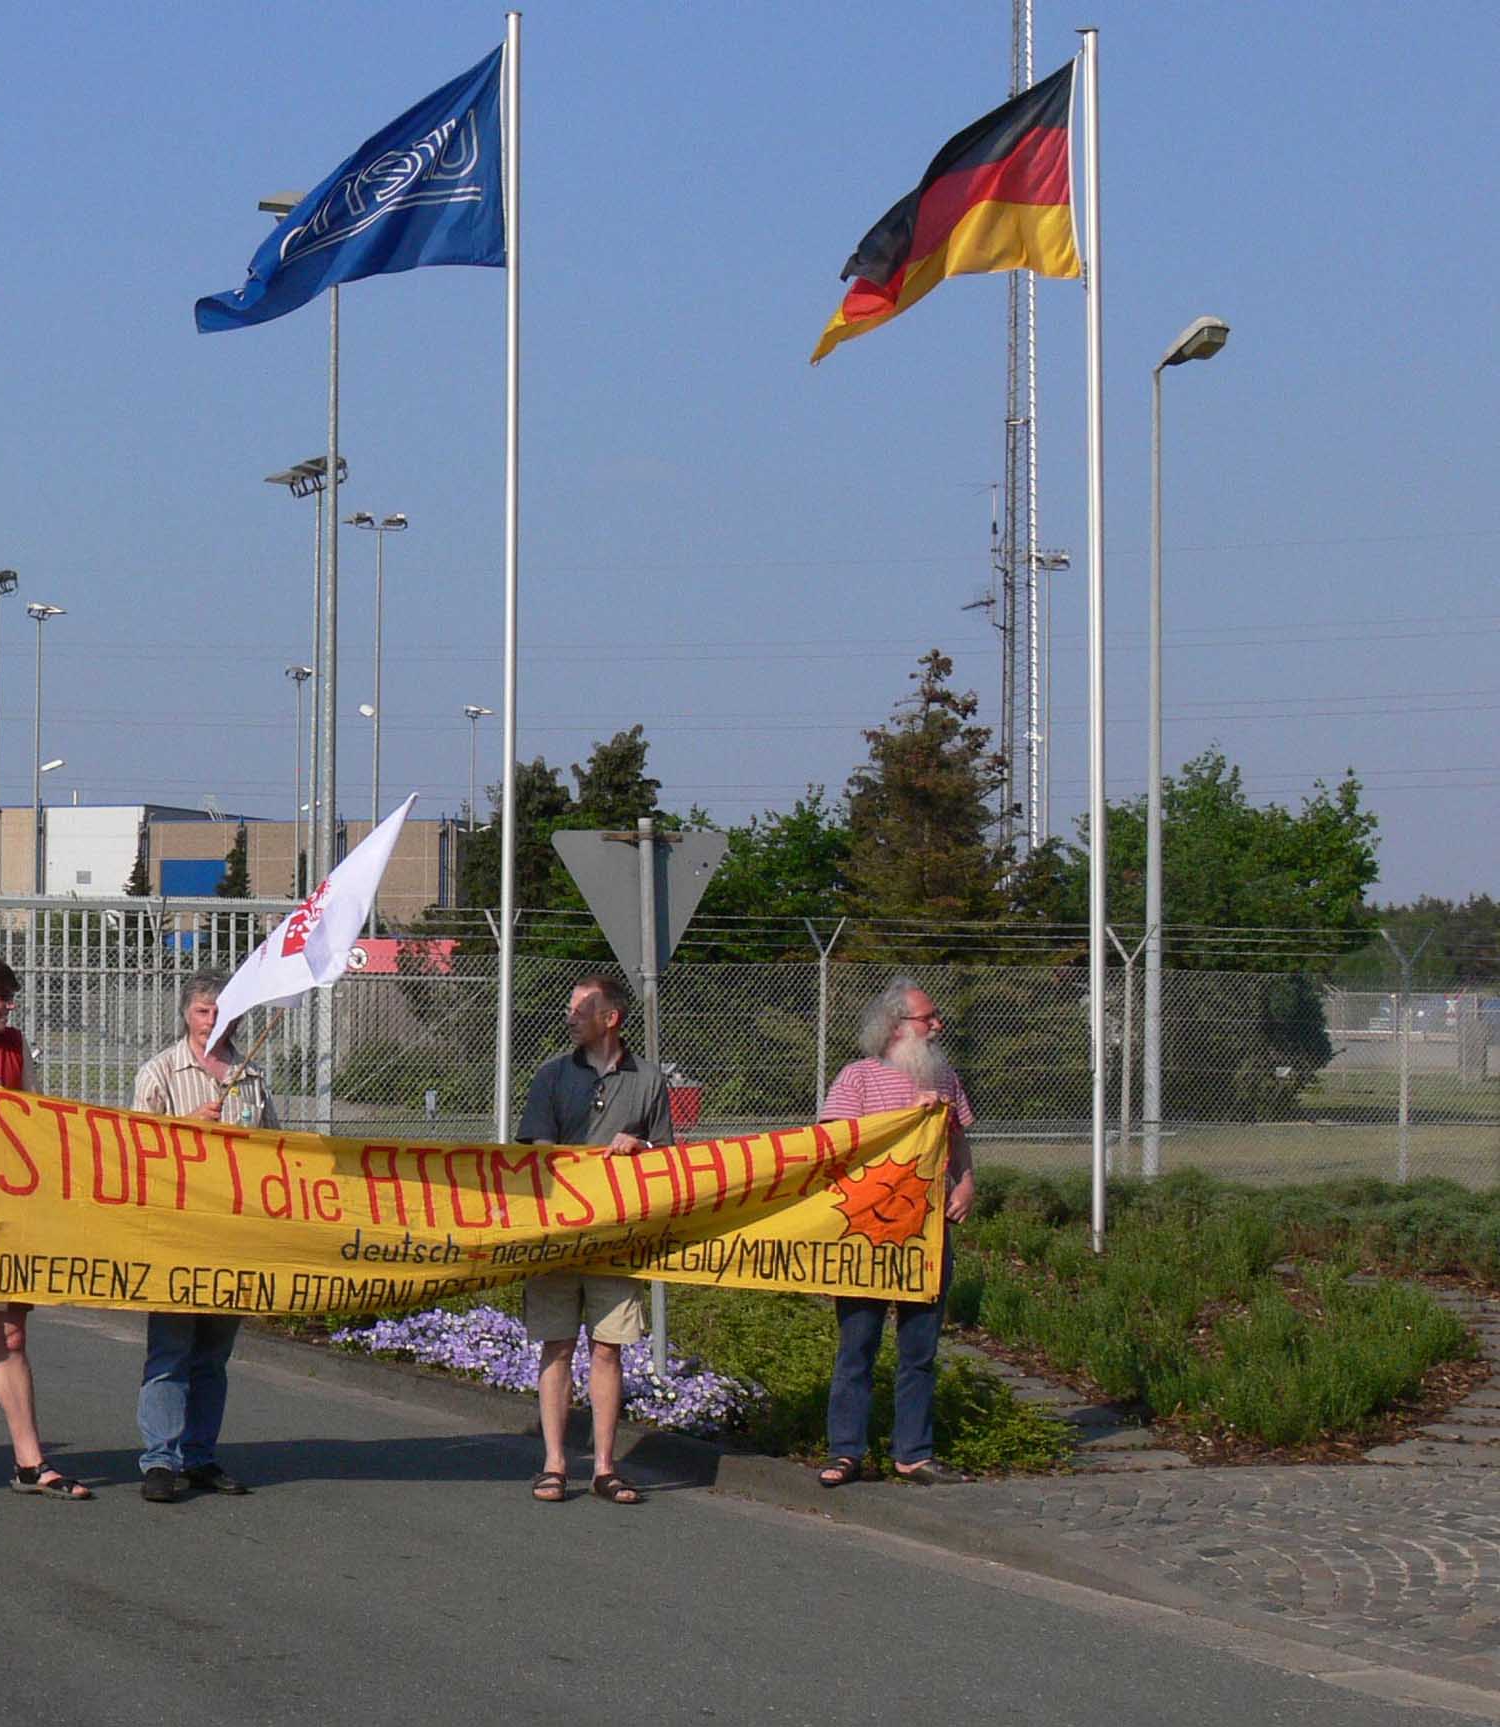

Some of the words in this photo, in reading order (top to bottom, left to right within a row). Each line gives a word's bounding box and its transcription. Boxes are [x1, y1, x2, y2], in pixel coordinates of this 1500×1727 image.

[260, 1137, 343, 1222] die
[360, 1118, 862, 1229] ATOMSTAATEN
[340, 1228, 461, 1265] deutsch
[168, 1267, 276, 1312] GEGEN
